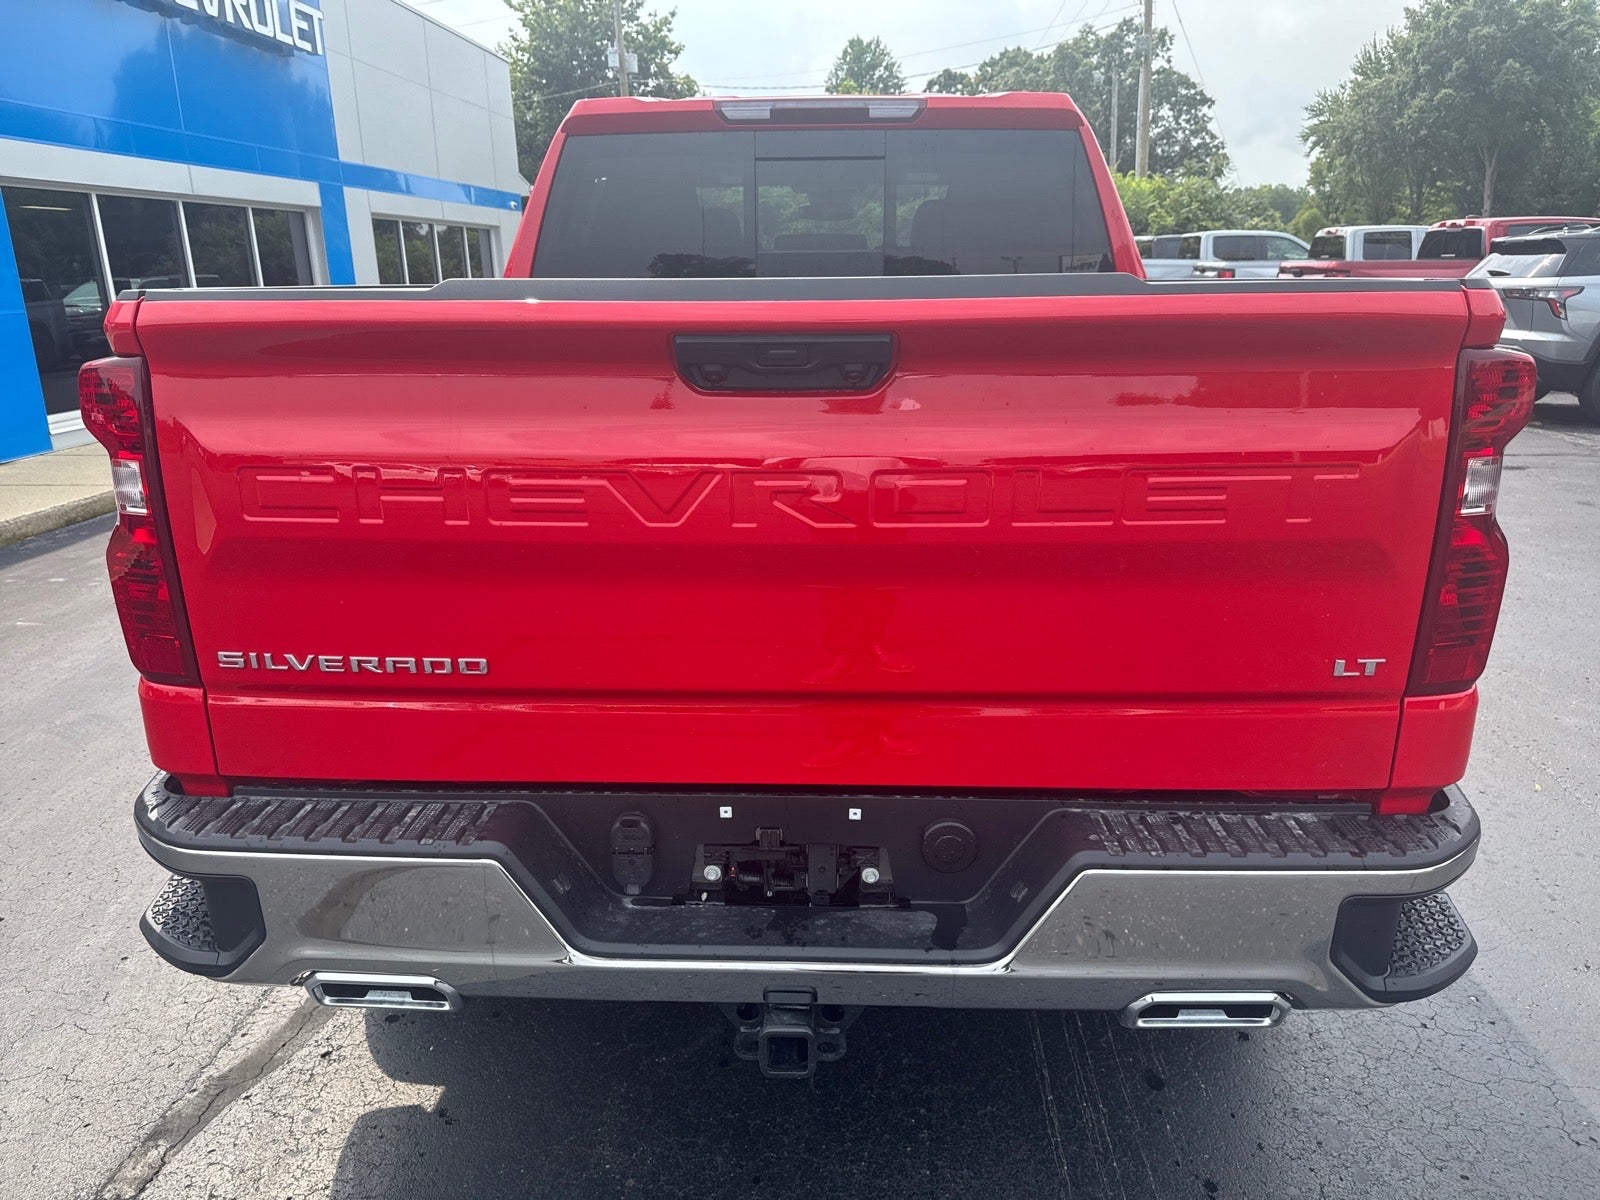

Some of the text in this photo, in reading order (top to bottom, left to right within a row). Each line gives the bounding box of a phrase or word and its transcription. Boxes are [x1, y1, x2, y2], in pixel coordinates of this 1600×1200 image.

[174, 0, 323, 55] ROLET
[237, 464, 1361, 528] CHEVROLET
[217, 651, 488, 675] SILVERADO
[1333, 658, 1386, 677] LT
